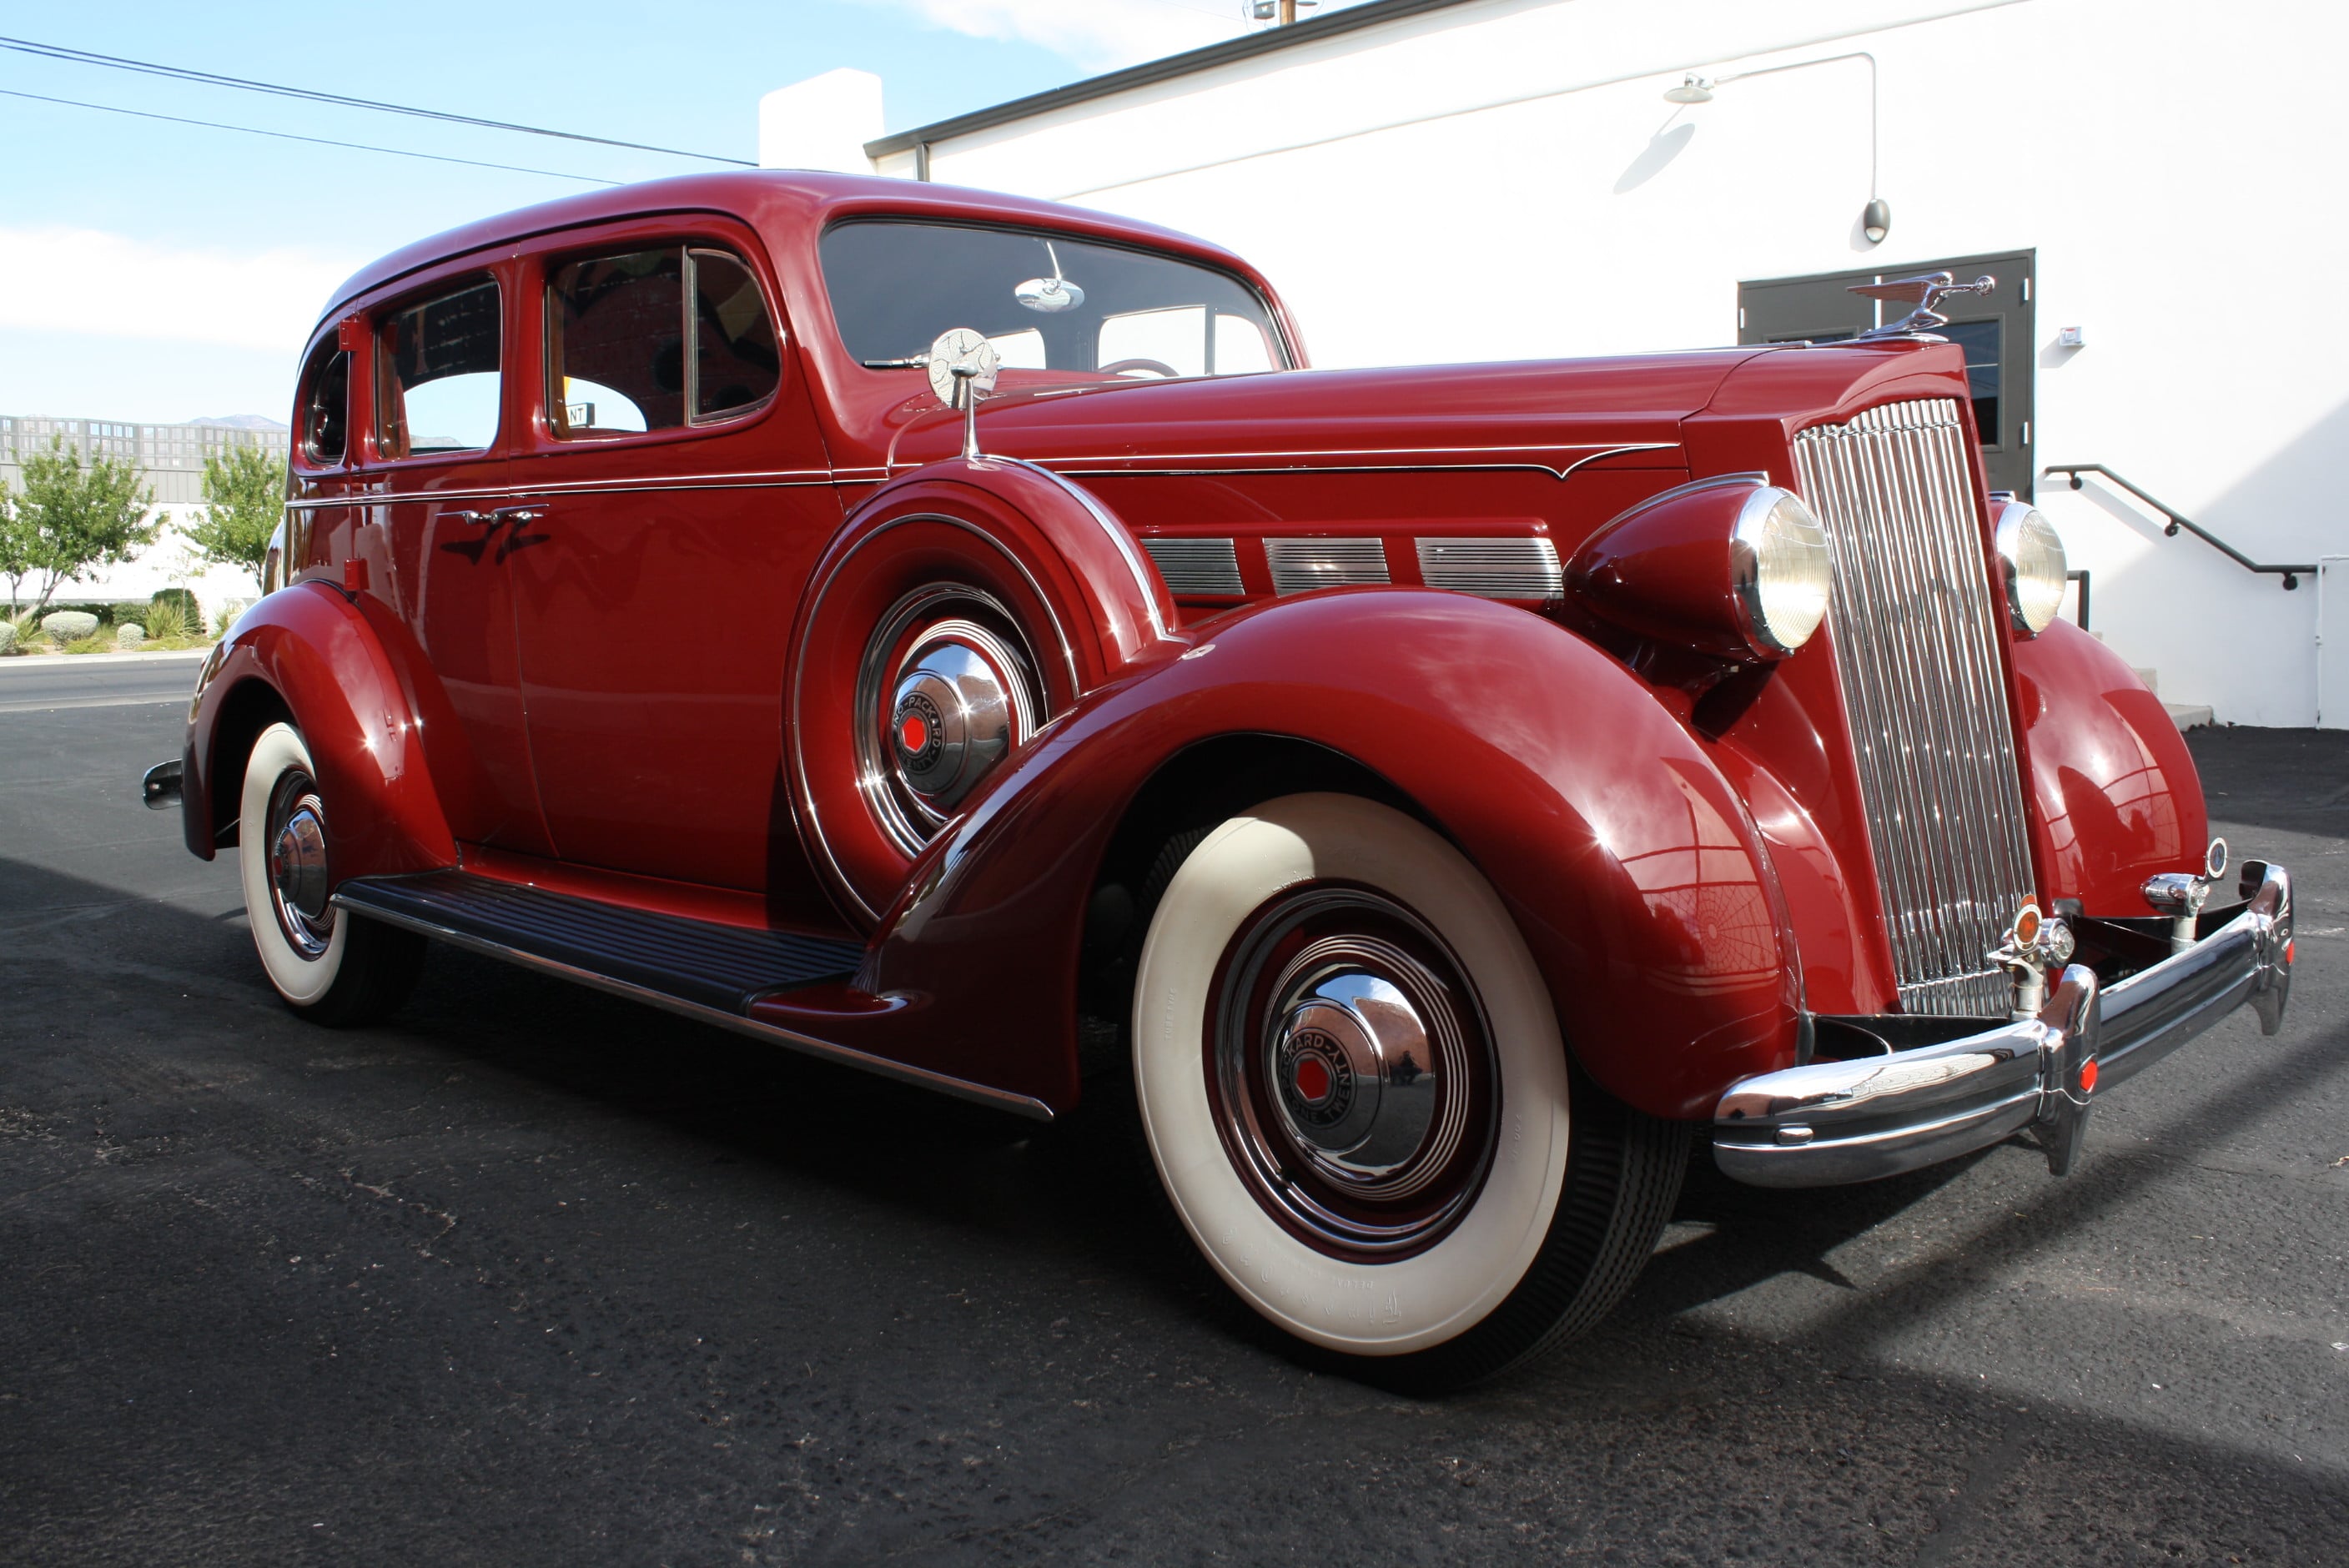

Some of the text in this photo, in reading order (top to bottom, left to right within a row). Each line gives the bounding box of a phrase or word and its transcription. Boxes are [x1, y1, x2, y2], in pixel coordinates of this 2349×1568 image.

[908, 696, 942, 747] PACKARD
[1283, 1033, 1325, 1088] PACKARD
[1291, 1050, 1351, 1123] ONE TWENTY
